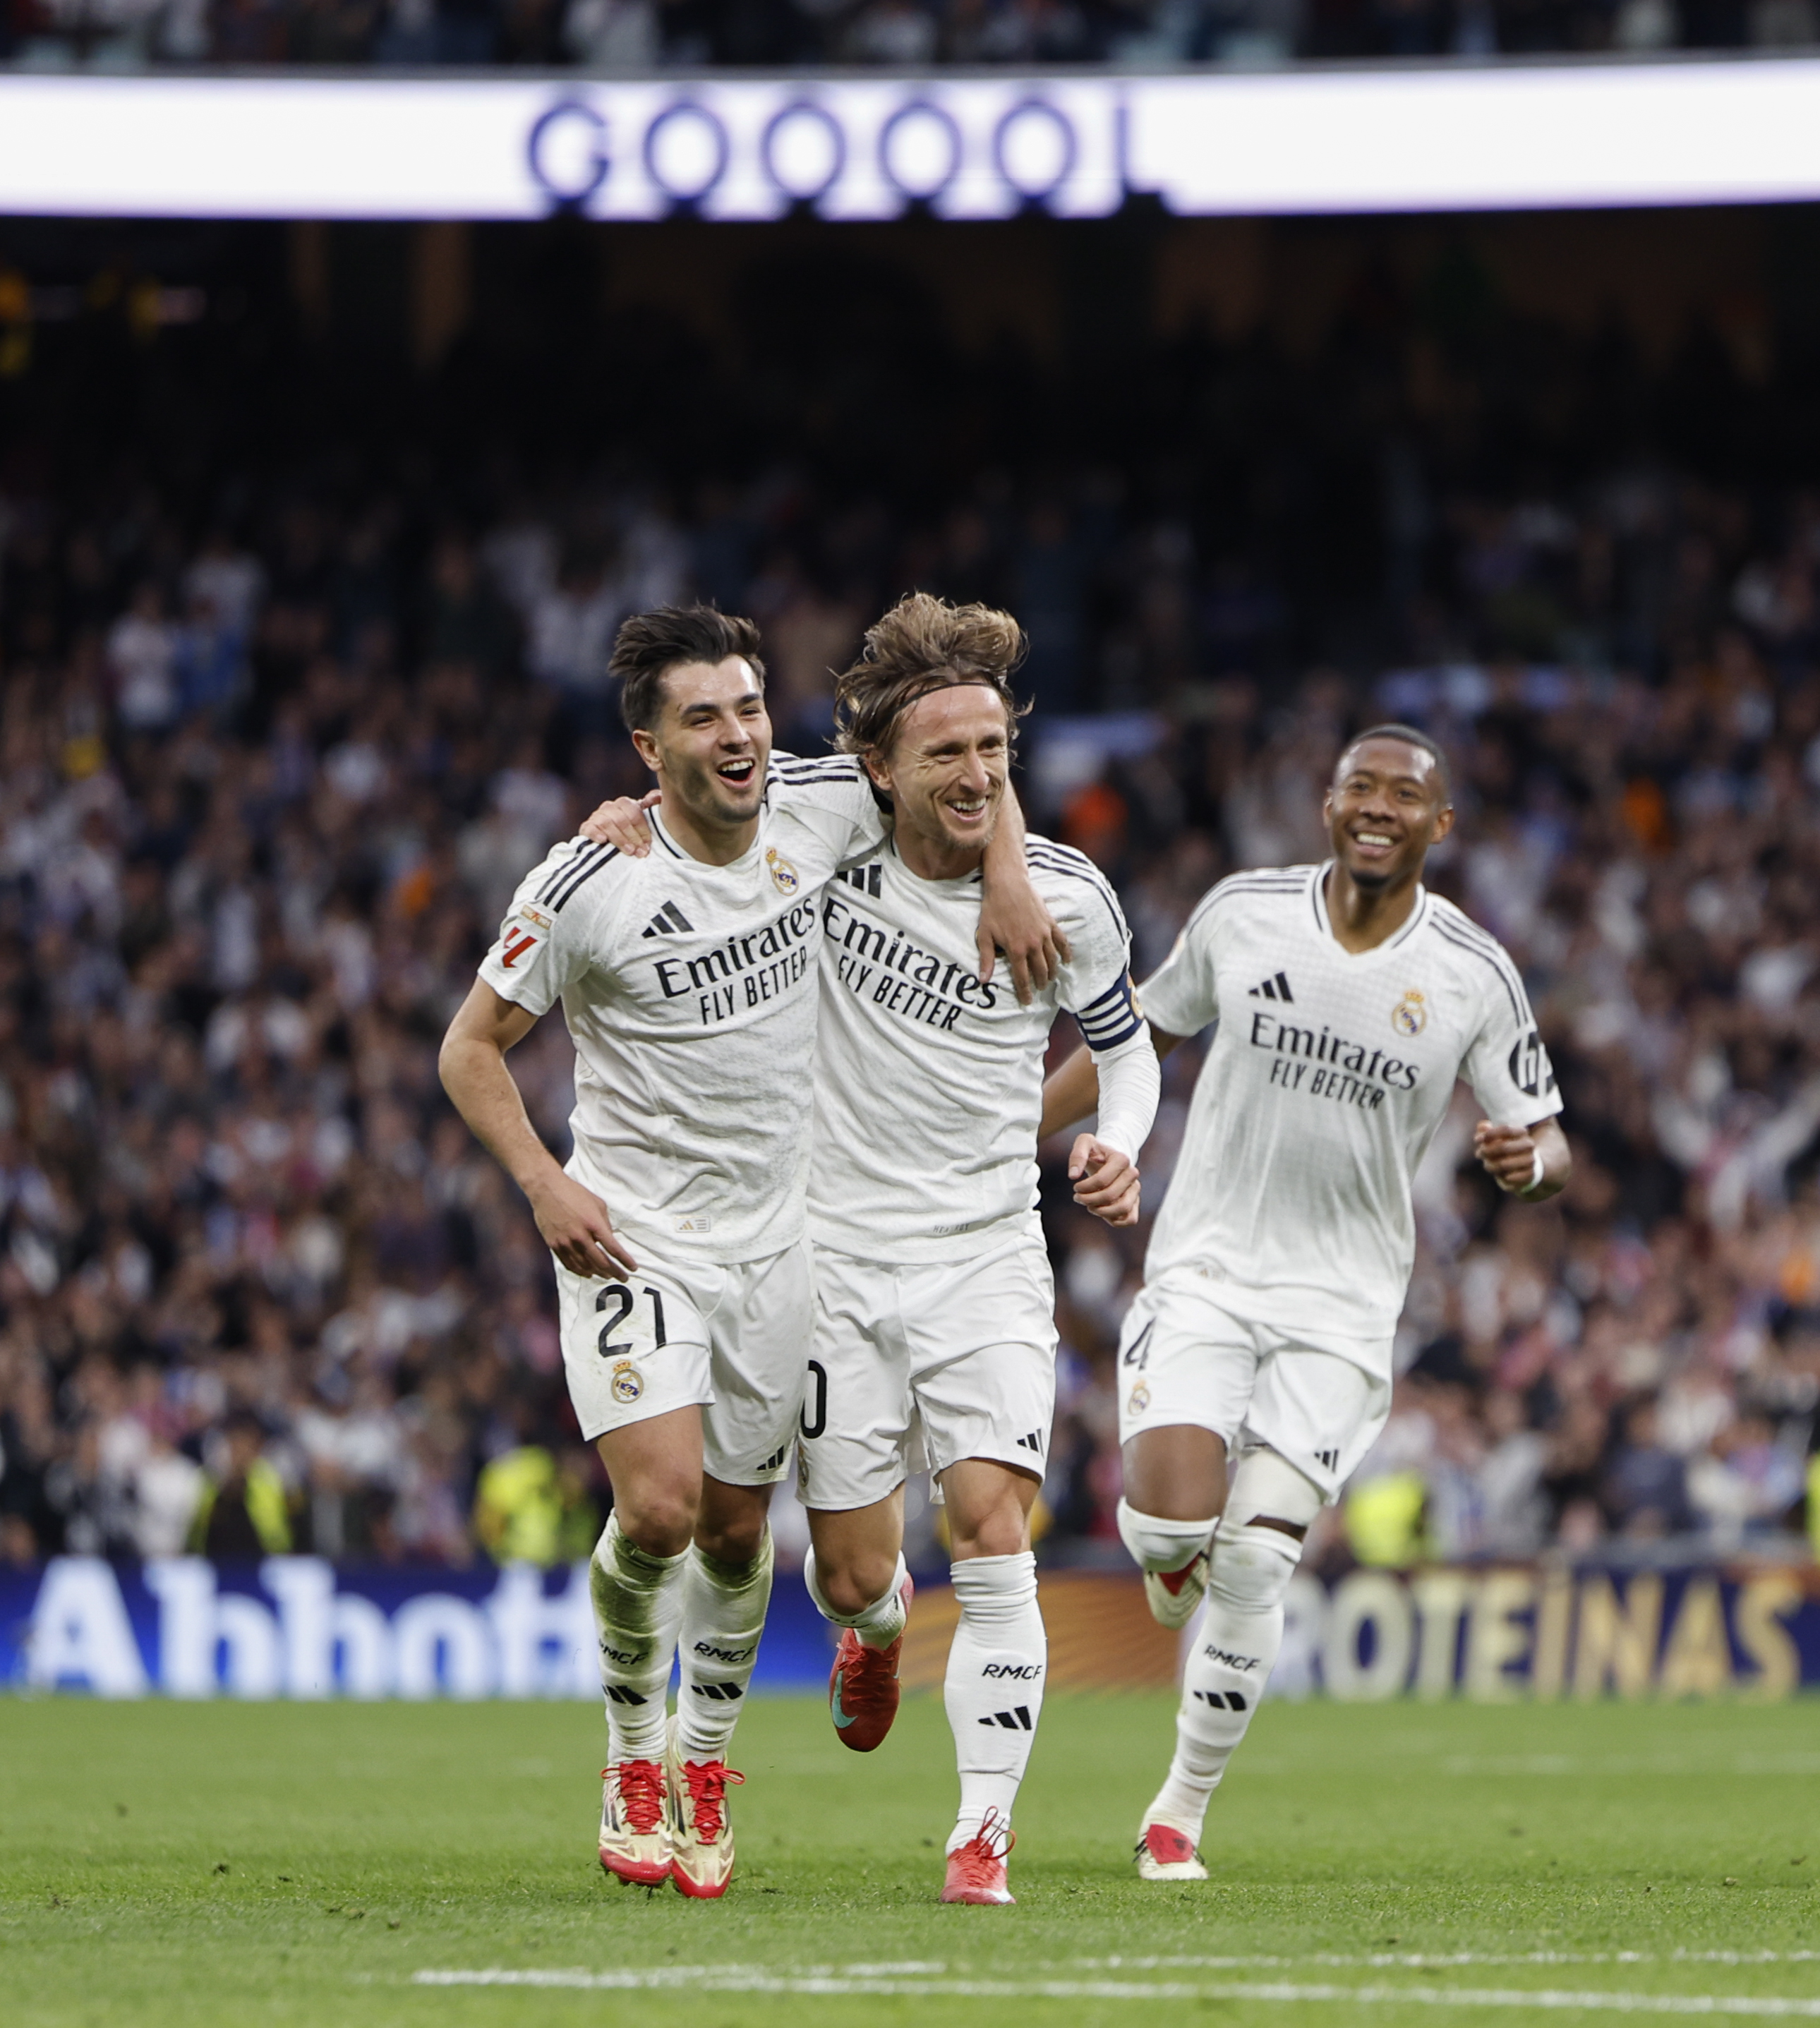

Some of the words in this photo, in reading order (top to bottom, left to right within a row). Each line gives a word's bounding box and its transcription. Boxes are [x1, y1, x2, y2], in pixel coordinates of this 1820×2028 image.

[526, 97, 1173, 216] GOOOOL
[652, 898, 815, 998] Emirates
[699, 984, 734, 1025] FLY
[743, 945, 807, 1008] BETTER
[823, 896, 998, 1010] Emirates
[837, 954, 873, 994] FLY
[873, 974, 963, 1031] BETTER
[1250, 1011, 1421, 1092] Emirates
[1270, 1056, 1308, 1090] FLY
[1310, 1071, 1385, 1111] BETTER
[596, 1283, 667, 1358] 21
[1123, 1315, 1157, 1371] 4
[981, 1663, 1043, 1680] RMCF
[1204, 1643, 1261, 1672] RMCF
